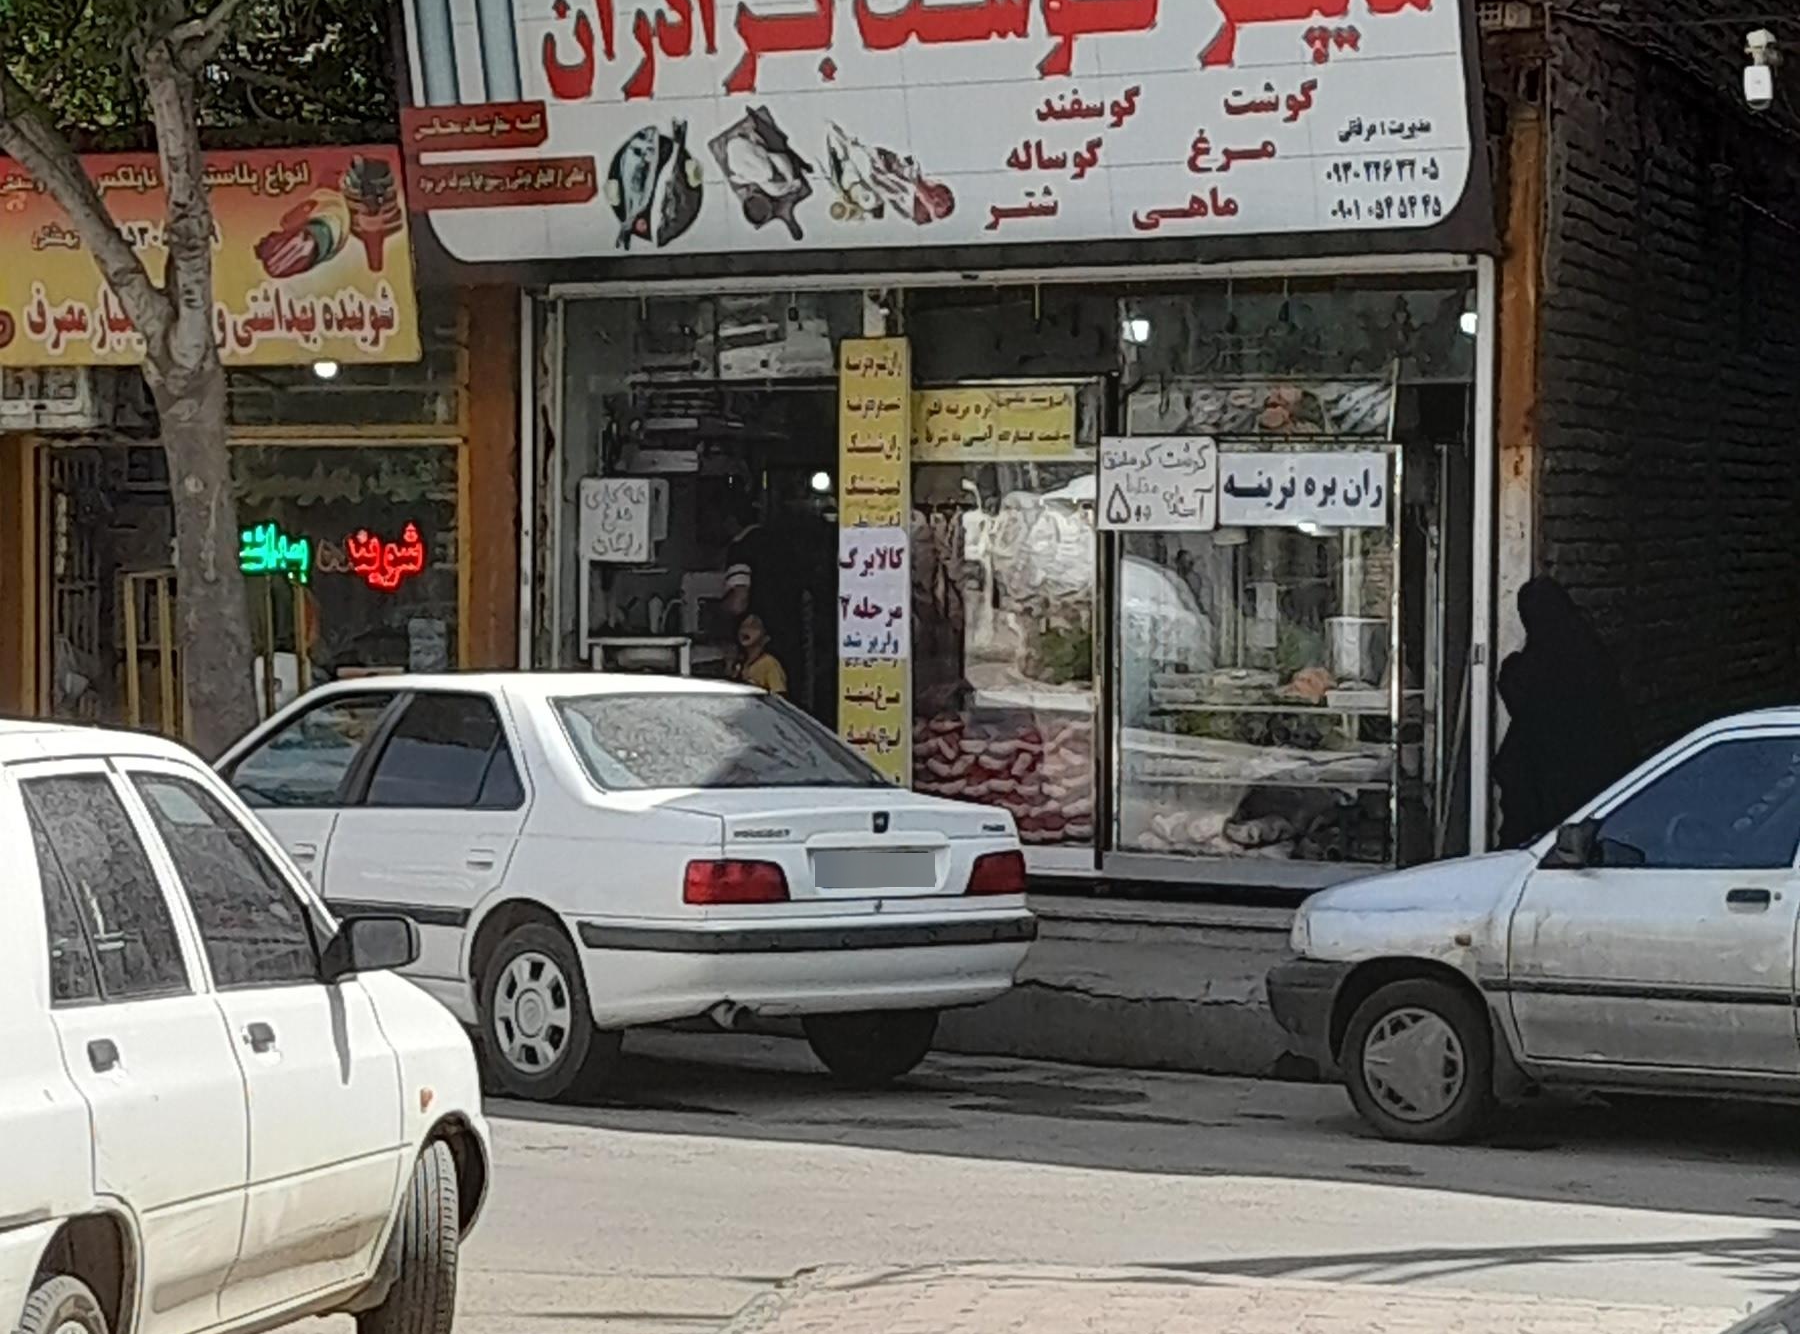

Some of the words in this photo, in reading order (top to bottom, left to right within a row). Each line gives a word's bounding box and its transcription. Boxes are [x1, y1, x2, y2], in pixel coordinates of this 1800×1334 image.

[1035, 86, 1141, 129] گوسفند
[1222, 79, 1318, 128] گوشت
[1005, 137, 1103, 180] گوساله
[1186, 128, 1277, 173] مرغ
[200, 163, 259, 195] پلاستی
[264, 162, 310, 195] انواع
[984, 186, 1059, 230] شتر
[1131, 186, 1239, 231] ماهی
[26, 286, 90, 351] مصرف
[231, 287, 317, 348] بهداشتی
[321, 287, 395, 346] شوینده
[1223, 466, 1297, 511] نرینه
[1303, 474, 1338, 508] بره
[1342, 468, 1384, 507] ران
[838, 546, 904, 577] کالابرگ
[852, 596, 903, 628] مرحله
[842, 631, 863, 648] شد
[867, 630, 899, 655] واریز
